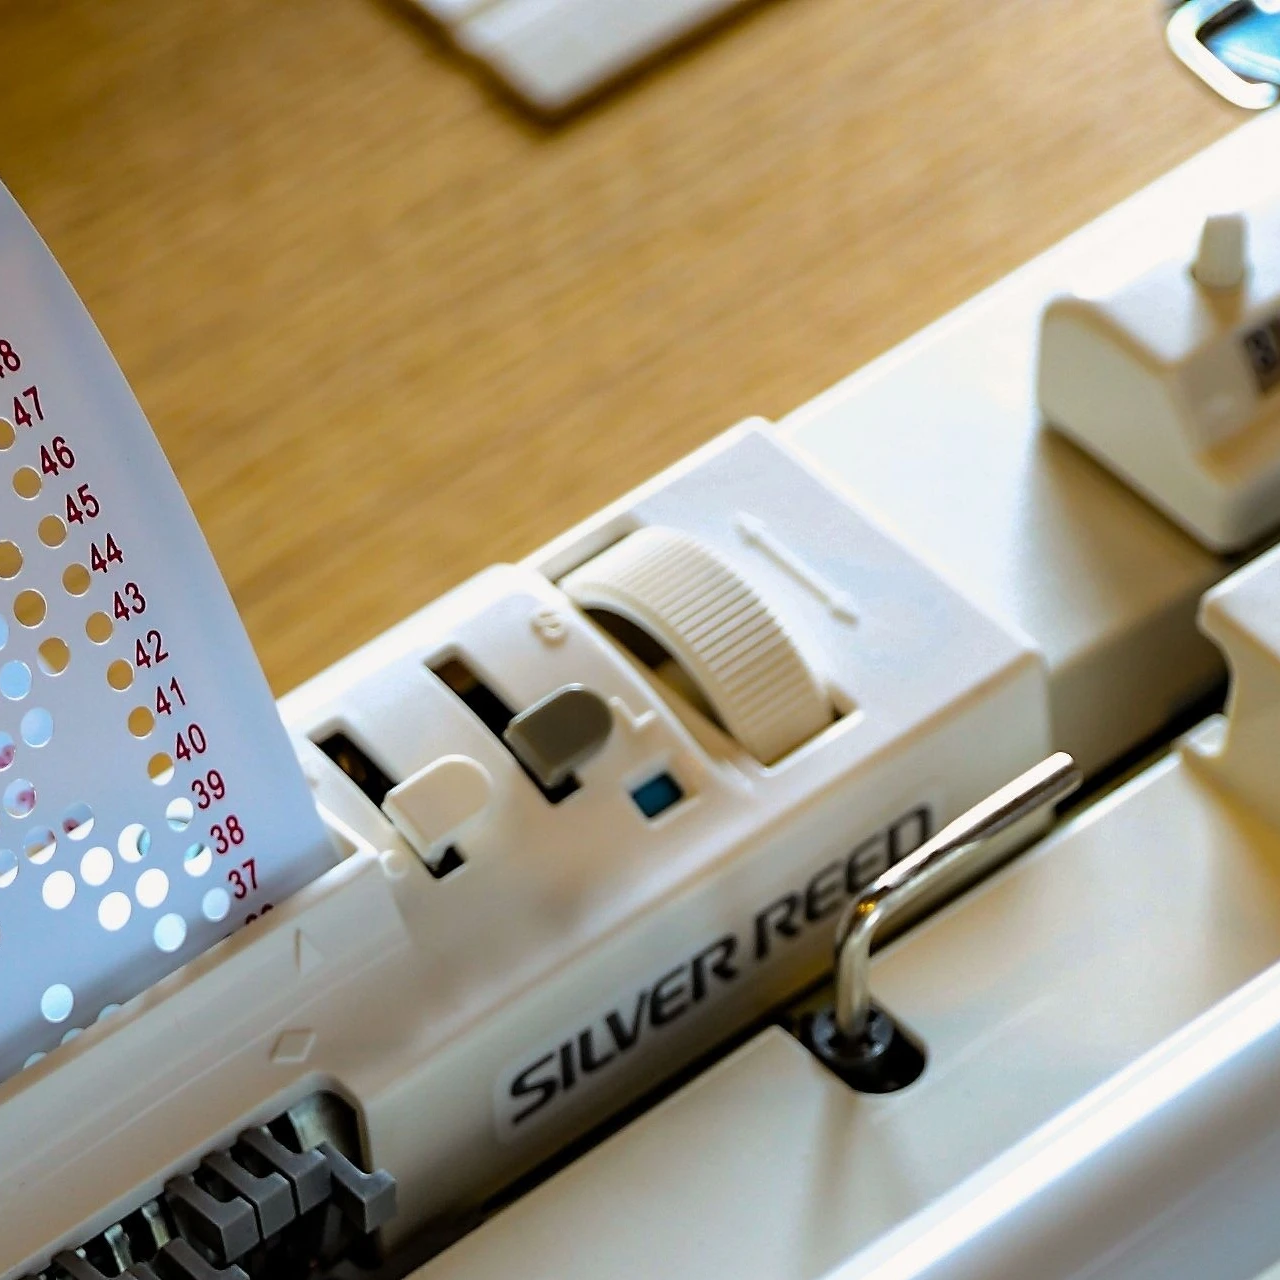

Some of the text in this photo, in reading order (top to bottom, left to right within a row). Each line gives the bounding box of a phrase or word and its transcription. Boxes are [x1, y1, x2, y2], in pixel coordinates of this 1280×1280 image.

[13, 385, 44, 427] 47
[40, 436, 75, 476] 46
[66, 483, 100, 524] 45
[90, 533, 123, 573] 44
[113, 582, 146, 621] 43
[135, 630, 169, 668] 42
[155, 677, 186, 715] 41
[175, 723, 207, 762] 40
[192, 769, 226, 809] 39
[210, 815, 245, 854] 38
[228, 858, 259, 899] 37
[509, 803, 932, 1126] SILVER REED
